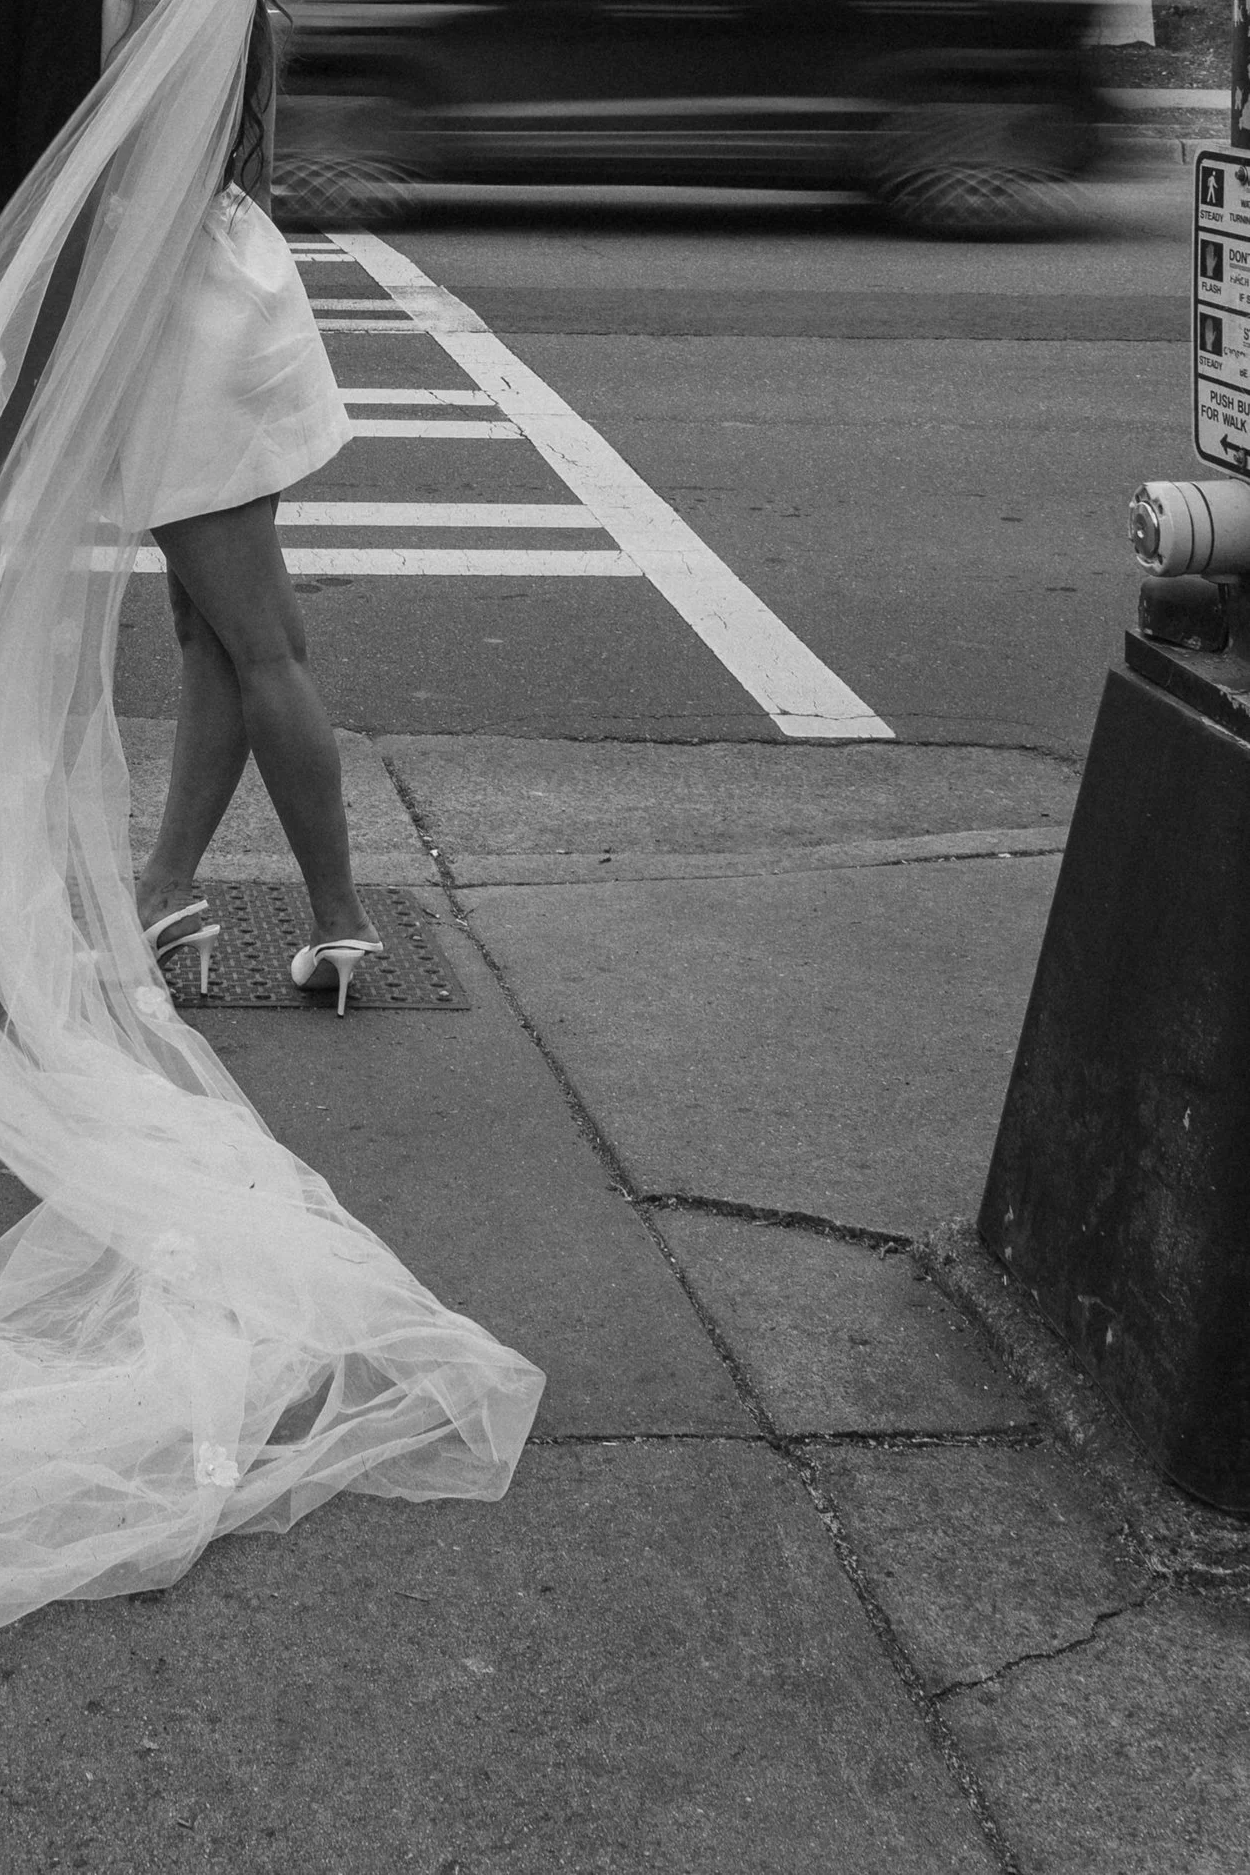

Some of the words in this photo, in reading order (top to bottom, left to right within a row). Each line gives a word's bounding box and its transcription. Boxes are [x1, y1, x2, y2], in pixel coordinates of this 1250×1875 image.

[1199, 209, 1224, 223] STEADY
[1201, 281, 1222, 295] FLASH
[1199, 355, 1223, 371] STEADY
[1210, 390, 1234, 410] PUSH
[1201, 403, 1219, 423] FOR
[1222, 412, 1247, 433] WALK
